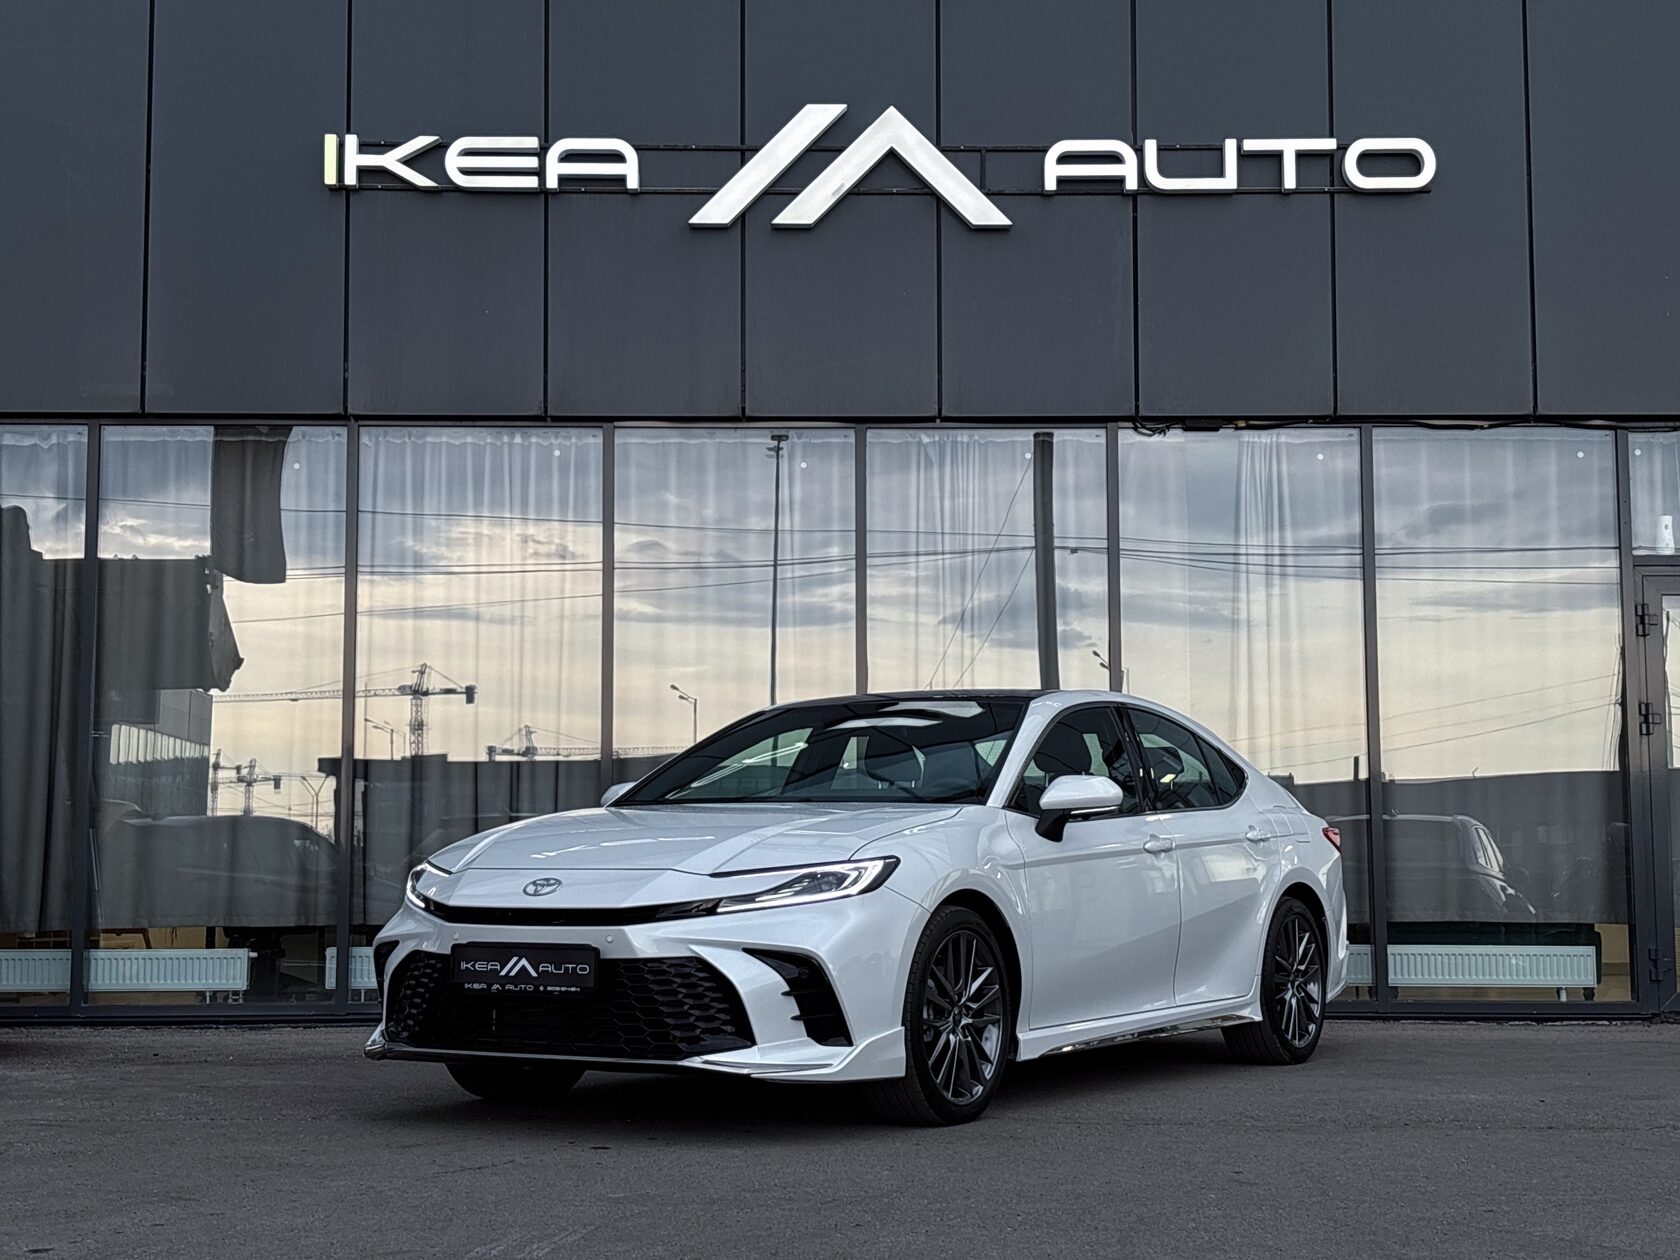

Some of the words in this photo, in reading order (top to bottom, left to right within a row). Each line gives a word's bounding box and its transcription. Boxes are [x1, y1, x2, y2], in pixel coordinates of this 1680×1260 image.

[324, 133, 640, 192] IKEA
[1043, 137, 1437, 194] AUTO
[460, 961, 500, 971] IKEA
[539, 963, 590, 974] AUTO
